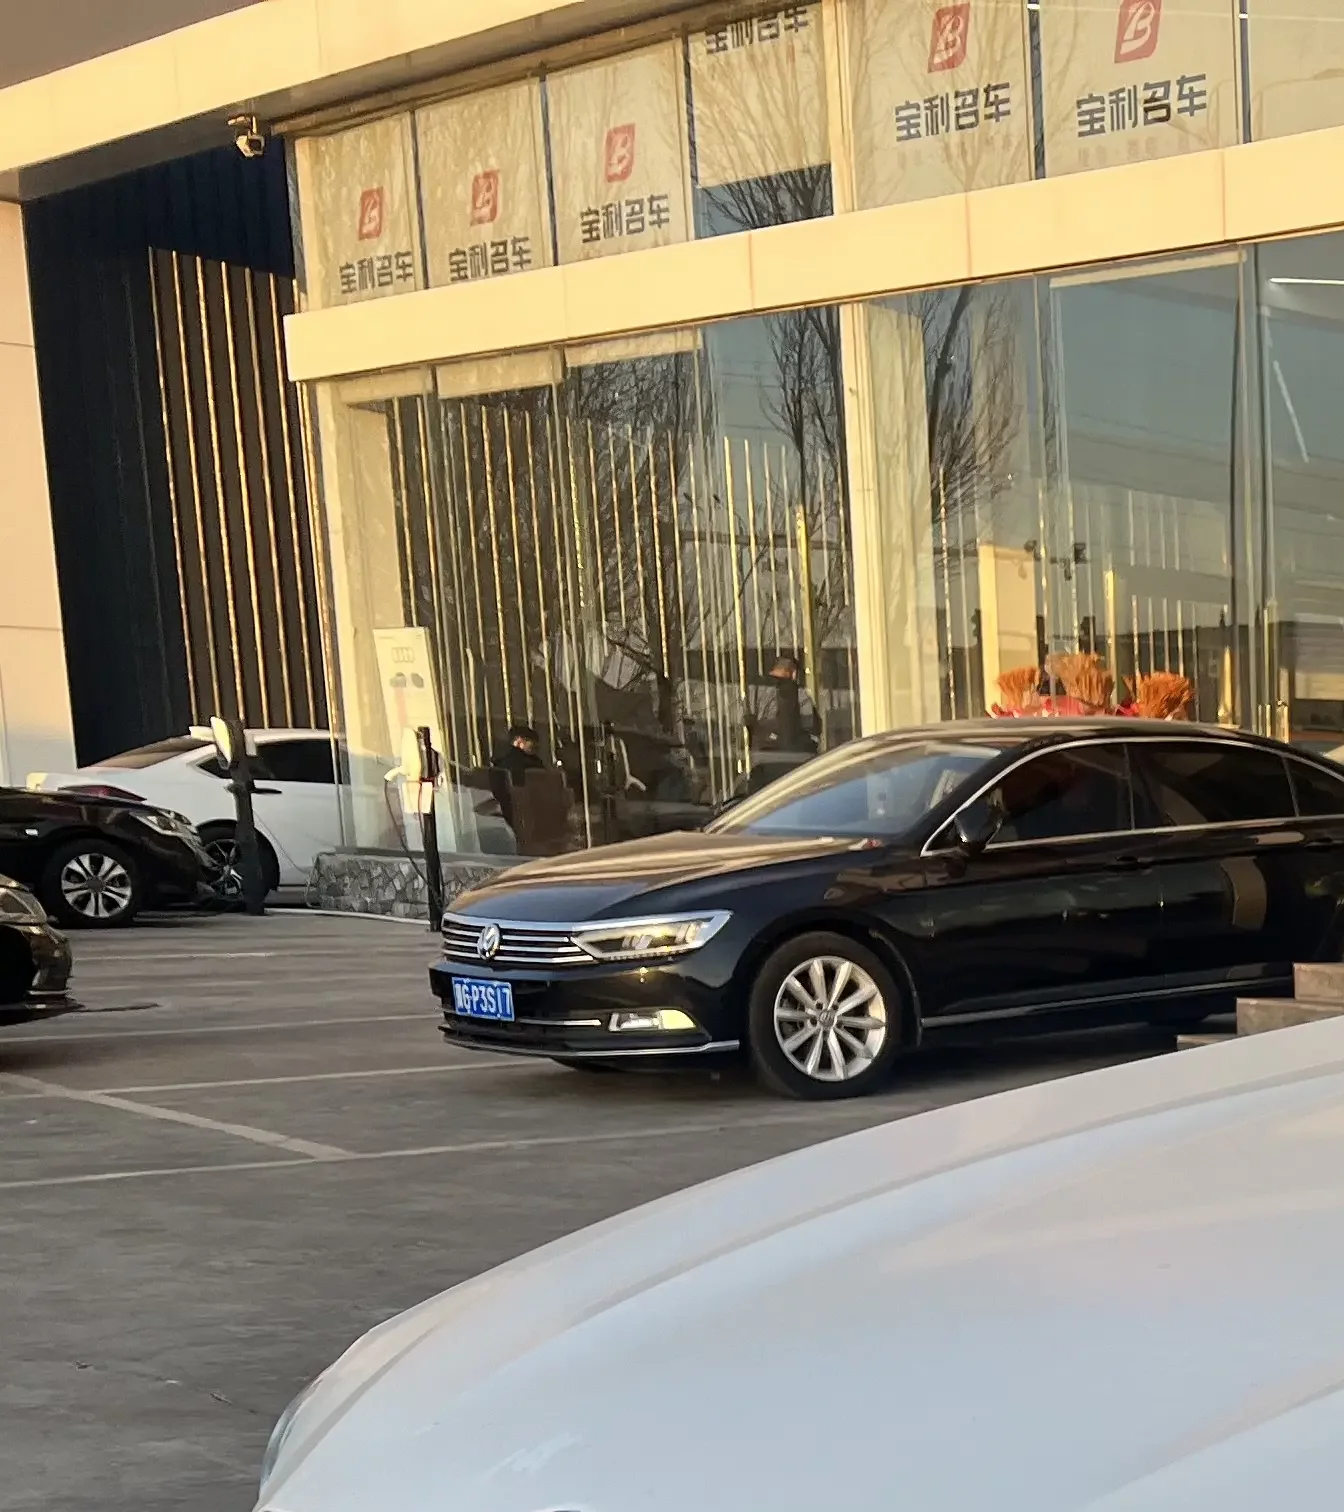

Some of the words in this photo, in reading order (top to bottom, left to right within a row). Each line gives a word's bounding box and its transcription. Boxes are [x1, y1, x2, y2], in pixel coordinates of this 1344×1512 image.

[894, 82, 1011, 142] 宝利名车
[1076, 73, 1207, 138] 宝利名车
[580, 194, 670, 244] 宝利名车
[339, 251, 414, 294] 宝利名车
[449, 236, 532, 283] 宝利名车
